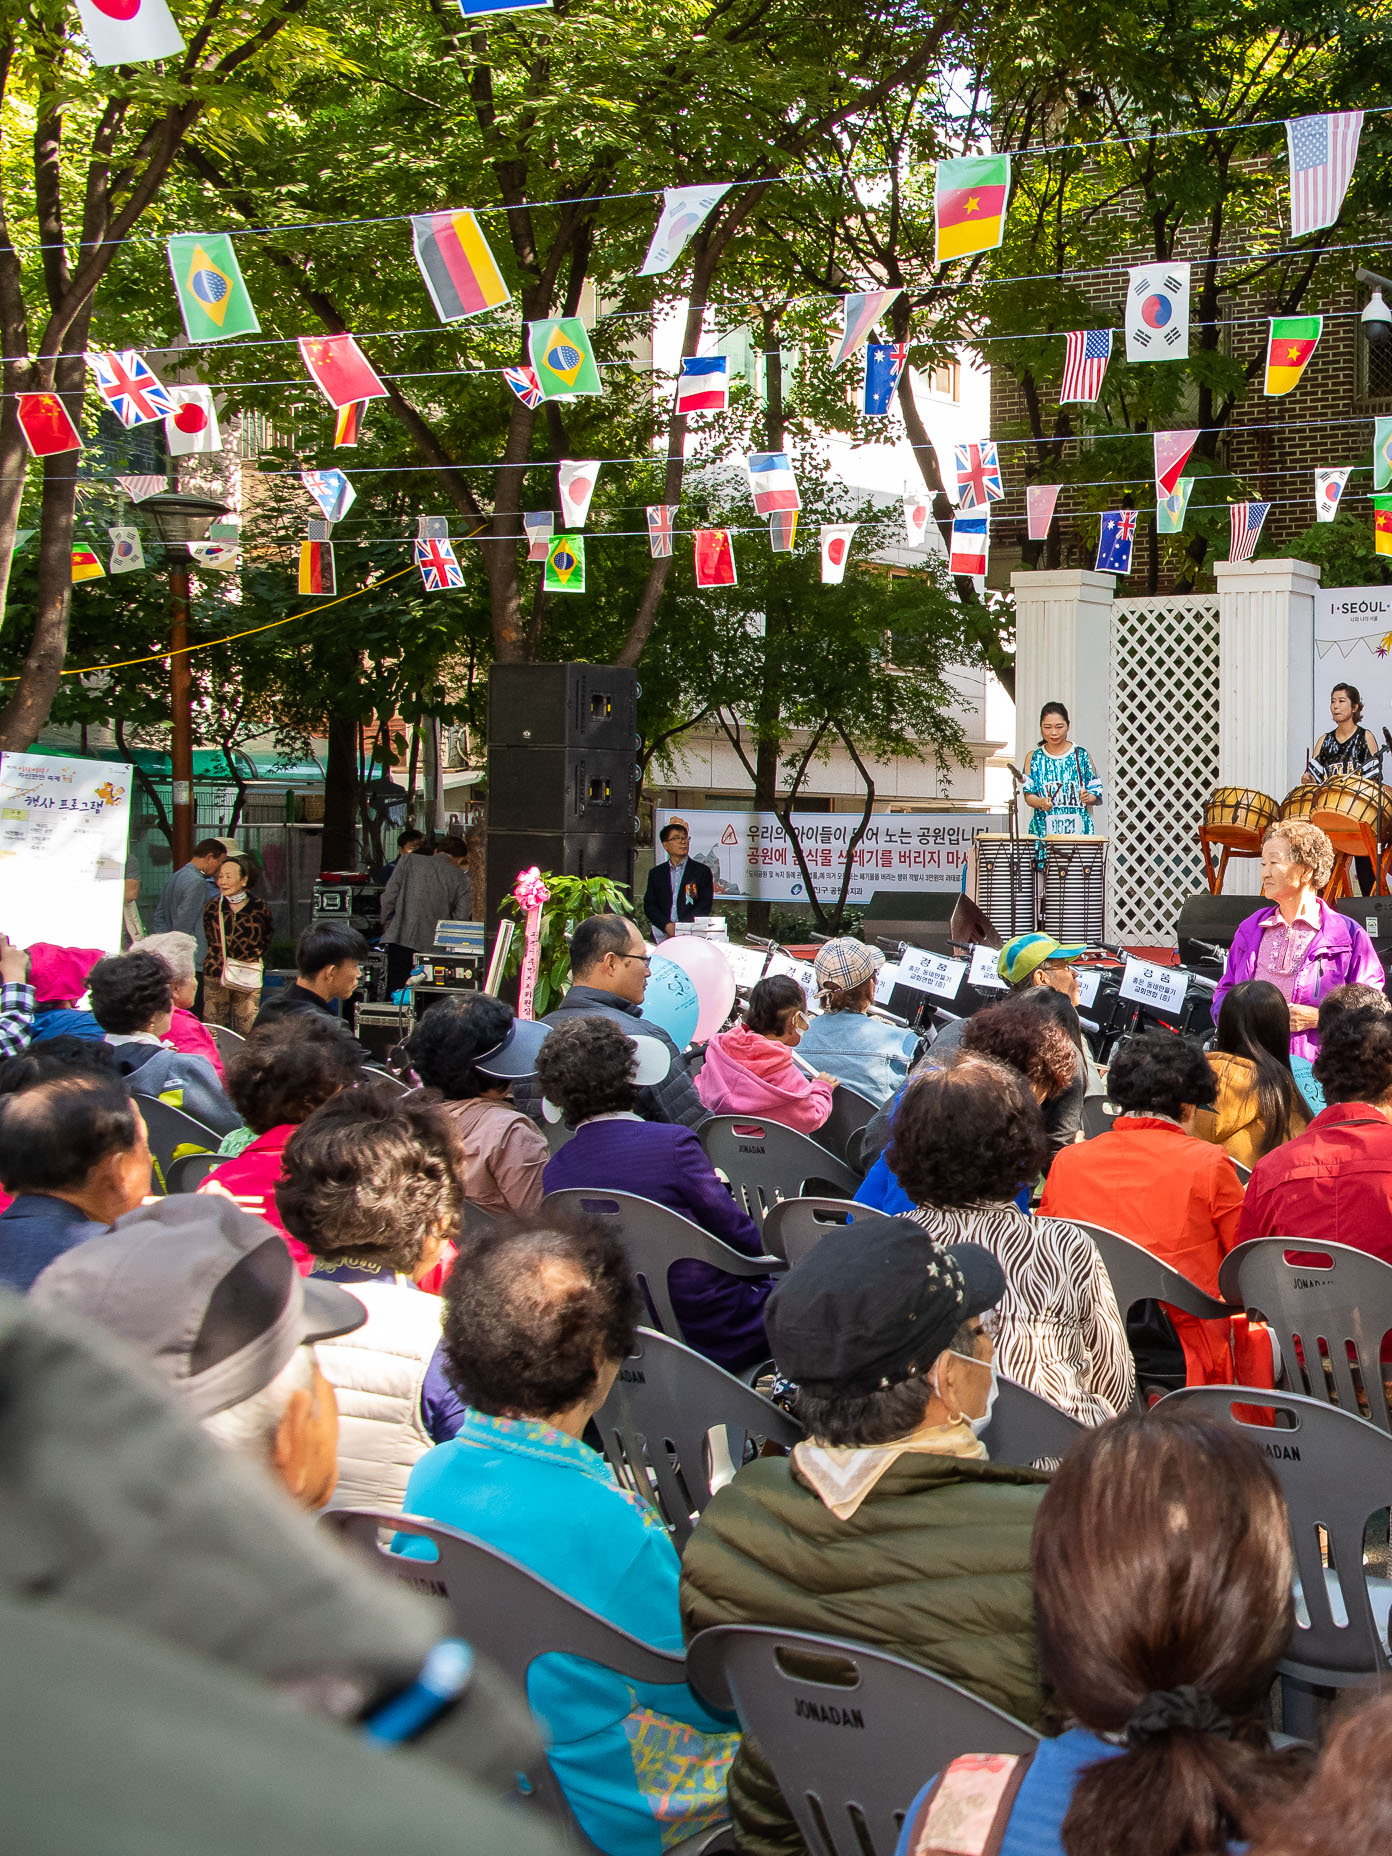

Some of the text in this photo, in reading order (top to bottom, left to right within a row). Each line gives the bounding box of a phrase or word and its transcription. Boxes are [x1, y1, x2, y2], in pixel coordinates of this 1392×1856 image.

[25, 795, 104, 814] 행사 프로그램
[747, 825, 786, 843] 우리의
[884, 828, 912, 845] 노는
[747, 847, 787, 866] 공원에
[898, 849, 940, 869] 버리지
[830, 886, 863, 896] 공원지과
[1265, 1443, 1301, 1462] ADAN
[794, 1696, 865, 1730] JONADAN
